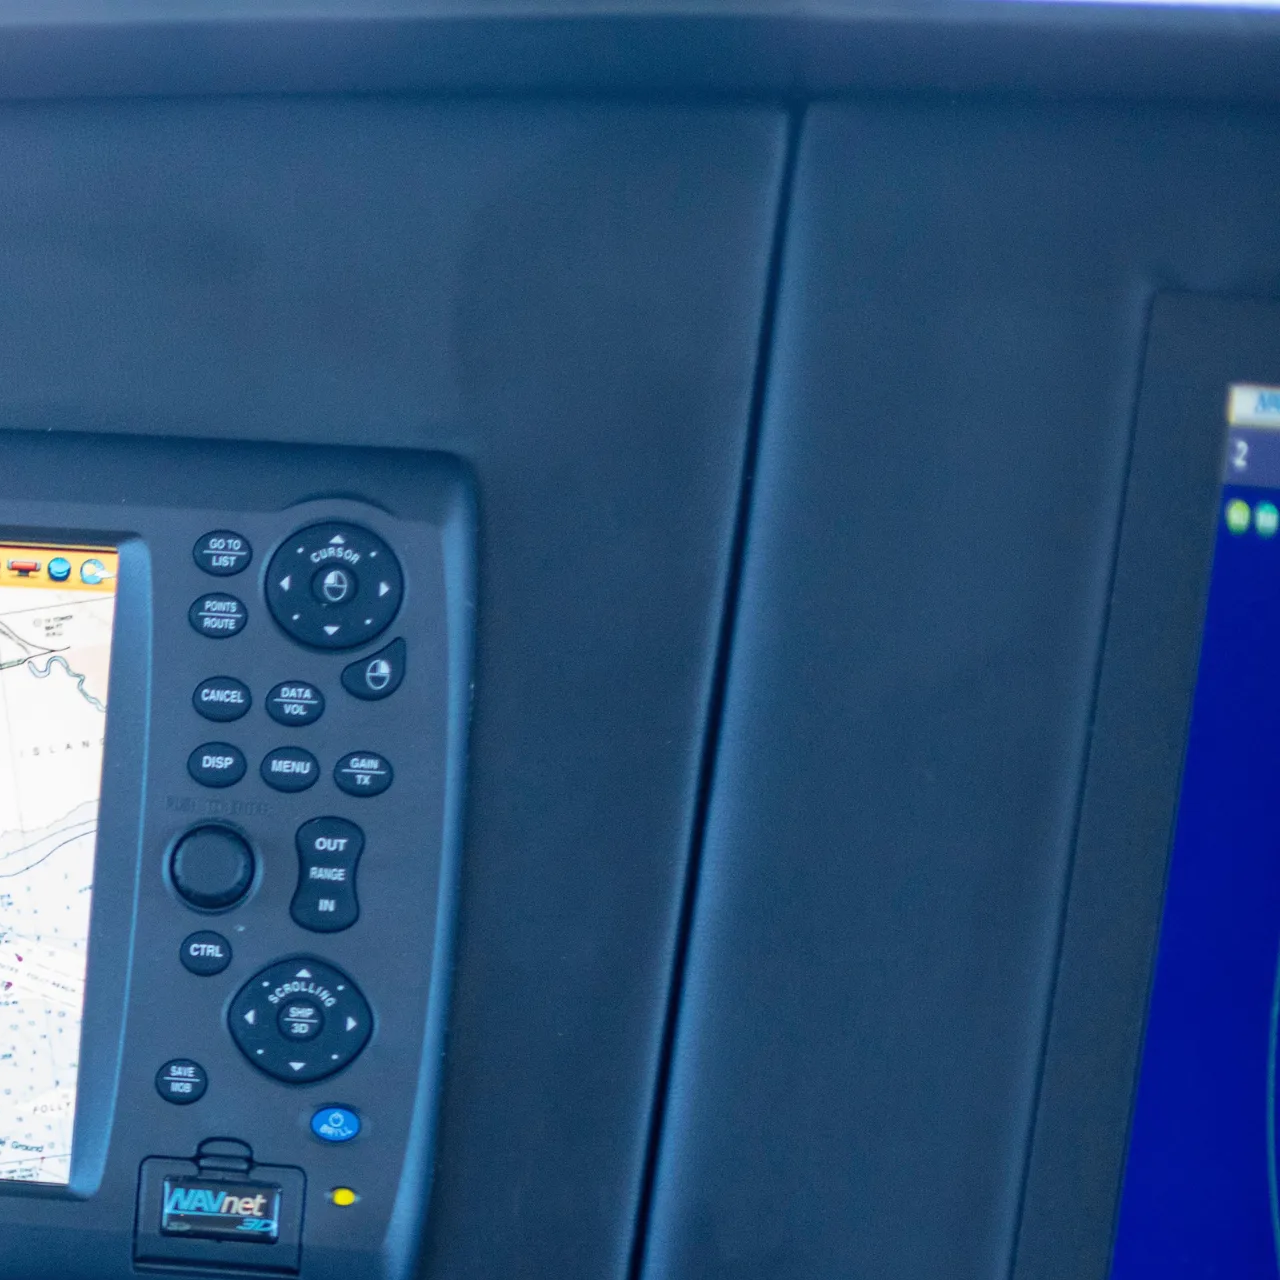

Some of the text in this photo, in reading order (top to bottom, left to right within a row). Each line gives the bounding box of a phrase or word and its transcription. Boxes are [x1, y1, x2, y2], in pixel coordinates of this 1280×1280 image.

[209, 538, 241, 550] GO TO
[212, 556, 236, 567] LIST
[310, 547, 361, 564] CURSOR
[204, 600, 237, 613] POINTS
[203, 618, 236, 629] ROUTE
[201, 688, 244, 703] CANCEL
[281, 688, 312, 700] DATA
[283, 704, 307, 716] VOL
[202, 756, 233, 769] DISP
[271, 760, 310, 774] MENU
[349, 758, 379, 770] GAIN
[356, 775, 371, 785] TX
[315, 837, 349, 851] OUT
[309, 866, 346, 881] RANGE
[318, 898, 335, 912] IN
[190, 943, 224, 958] CTRL
[268, 980, 337, 1008] SCROLLING
[289, 1006, 314, 1018] SHIP
[291, 1022, 309, 1034] 3D
[170, 1066, 195, 1077] SAVE
[167, 1187, 267, 1217] NAVnet
